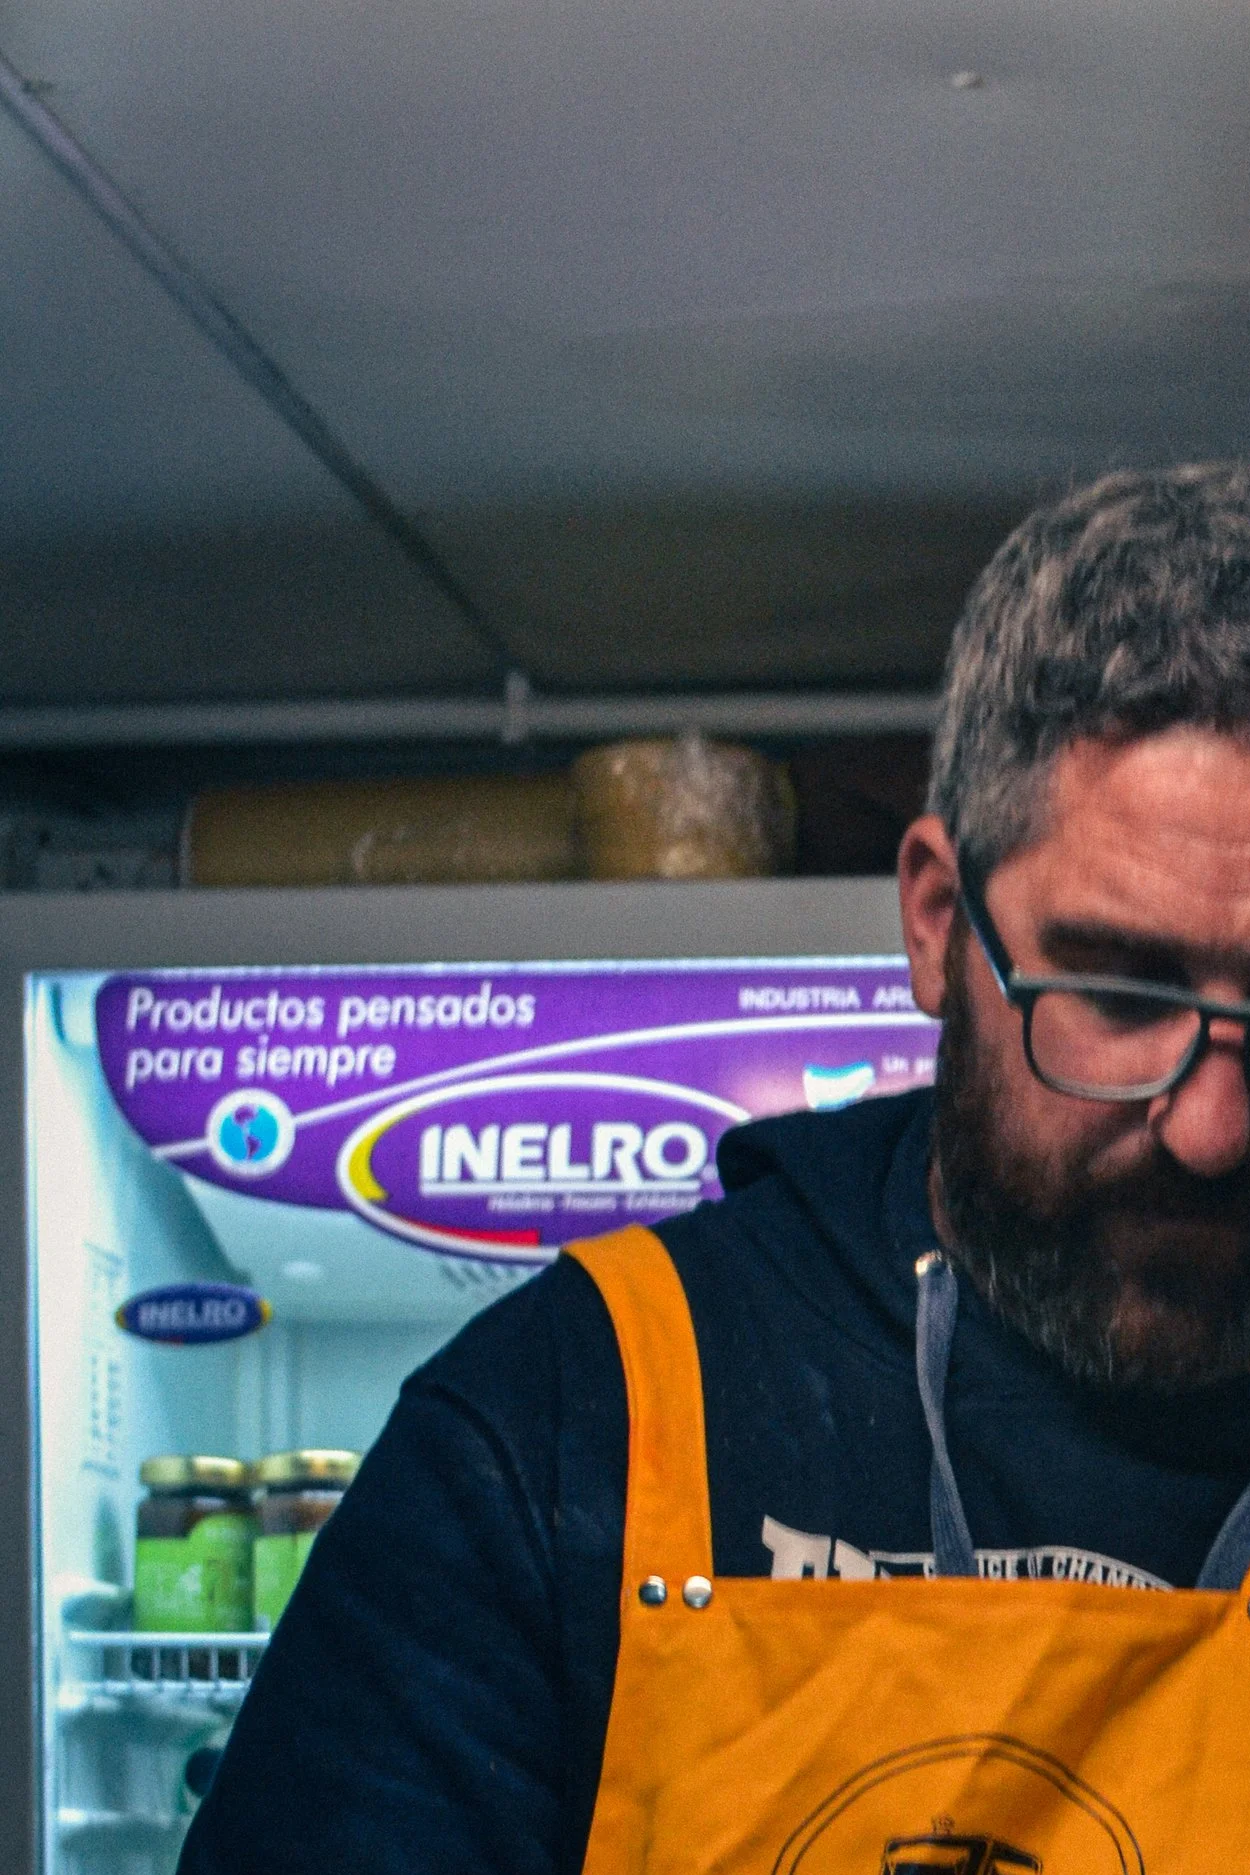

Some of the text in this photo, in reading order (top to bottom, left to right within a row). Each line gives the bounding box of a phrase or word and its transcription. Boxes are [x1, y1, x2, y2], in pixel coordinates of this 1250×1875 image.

[127, 980, 536, 1038] Productos pensados
[738, 985, 862, 1010] INDUSTRIA
[126, 1034, 397, 1090] para siempre
[420, 1121, 708, 1185] INELRO
